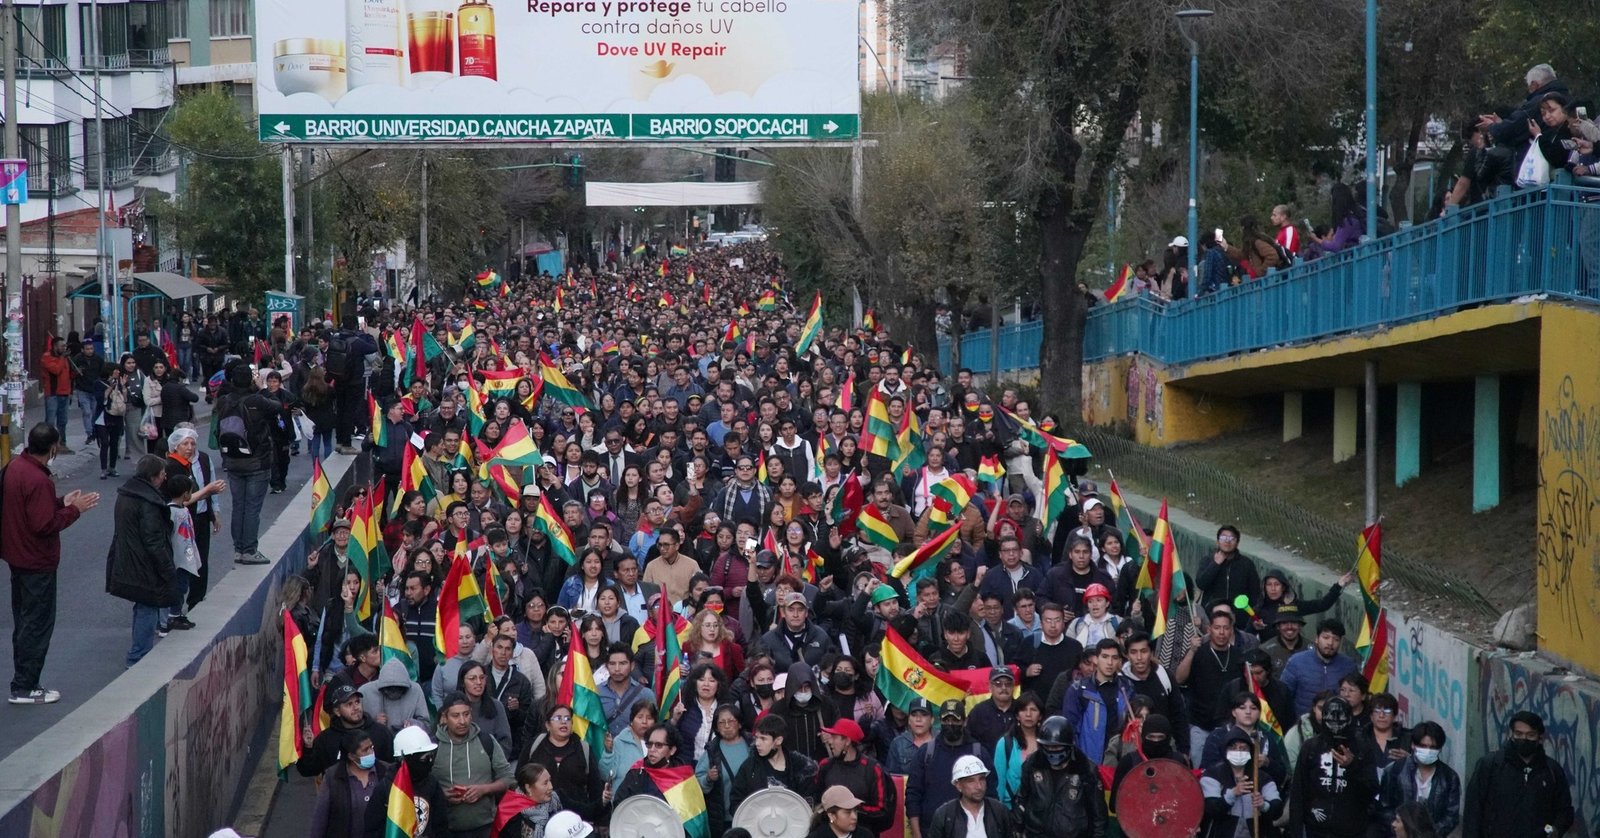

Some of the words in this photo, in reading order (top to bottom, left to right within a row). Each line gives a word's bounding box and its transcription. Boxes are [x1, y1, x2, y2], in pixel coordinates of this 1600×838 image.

[527, 0, 596, 17] Repara
[602, 2, 611, 17] y
[617, 0, 691, 17] protege
[697, 0, 714, 13] tu
[720, 0, 787, 13] cabello
[581, 20, 640, 34] contra
[646, 18, 703, 34] daños
[709, 19, 735, 34] UV
[597, 42, 639, 56] Dove
[644, 42, 667, 56] UV
[671, 41, 727, 60] Repair
[305, 119, 369, 136] BARRIO
[371, 119, 480, 136] UNIVERSIDAD
[482, 119, 552, 136] CANCHA
[553, 119, 614, 135] ZAPATA
[650, 118, 712, 135] BARRIO
[714, 118, 809, 135] SOPOCACHI
[1398, 638, 1463, 731] CENSO
